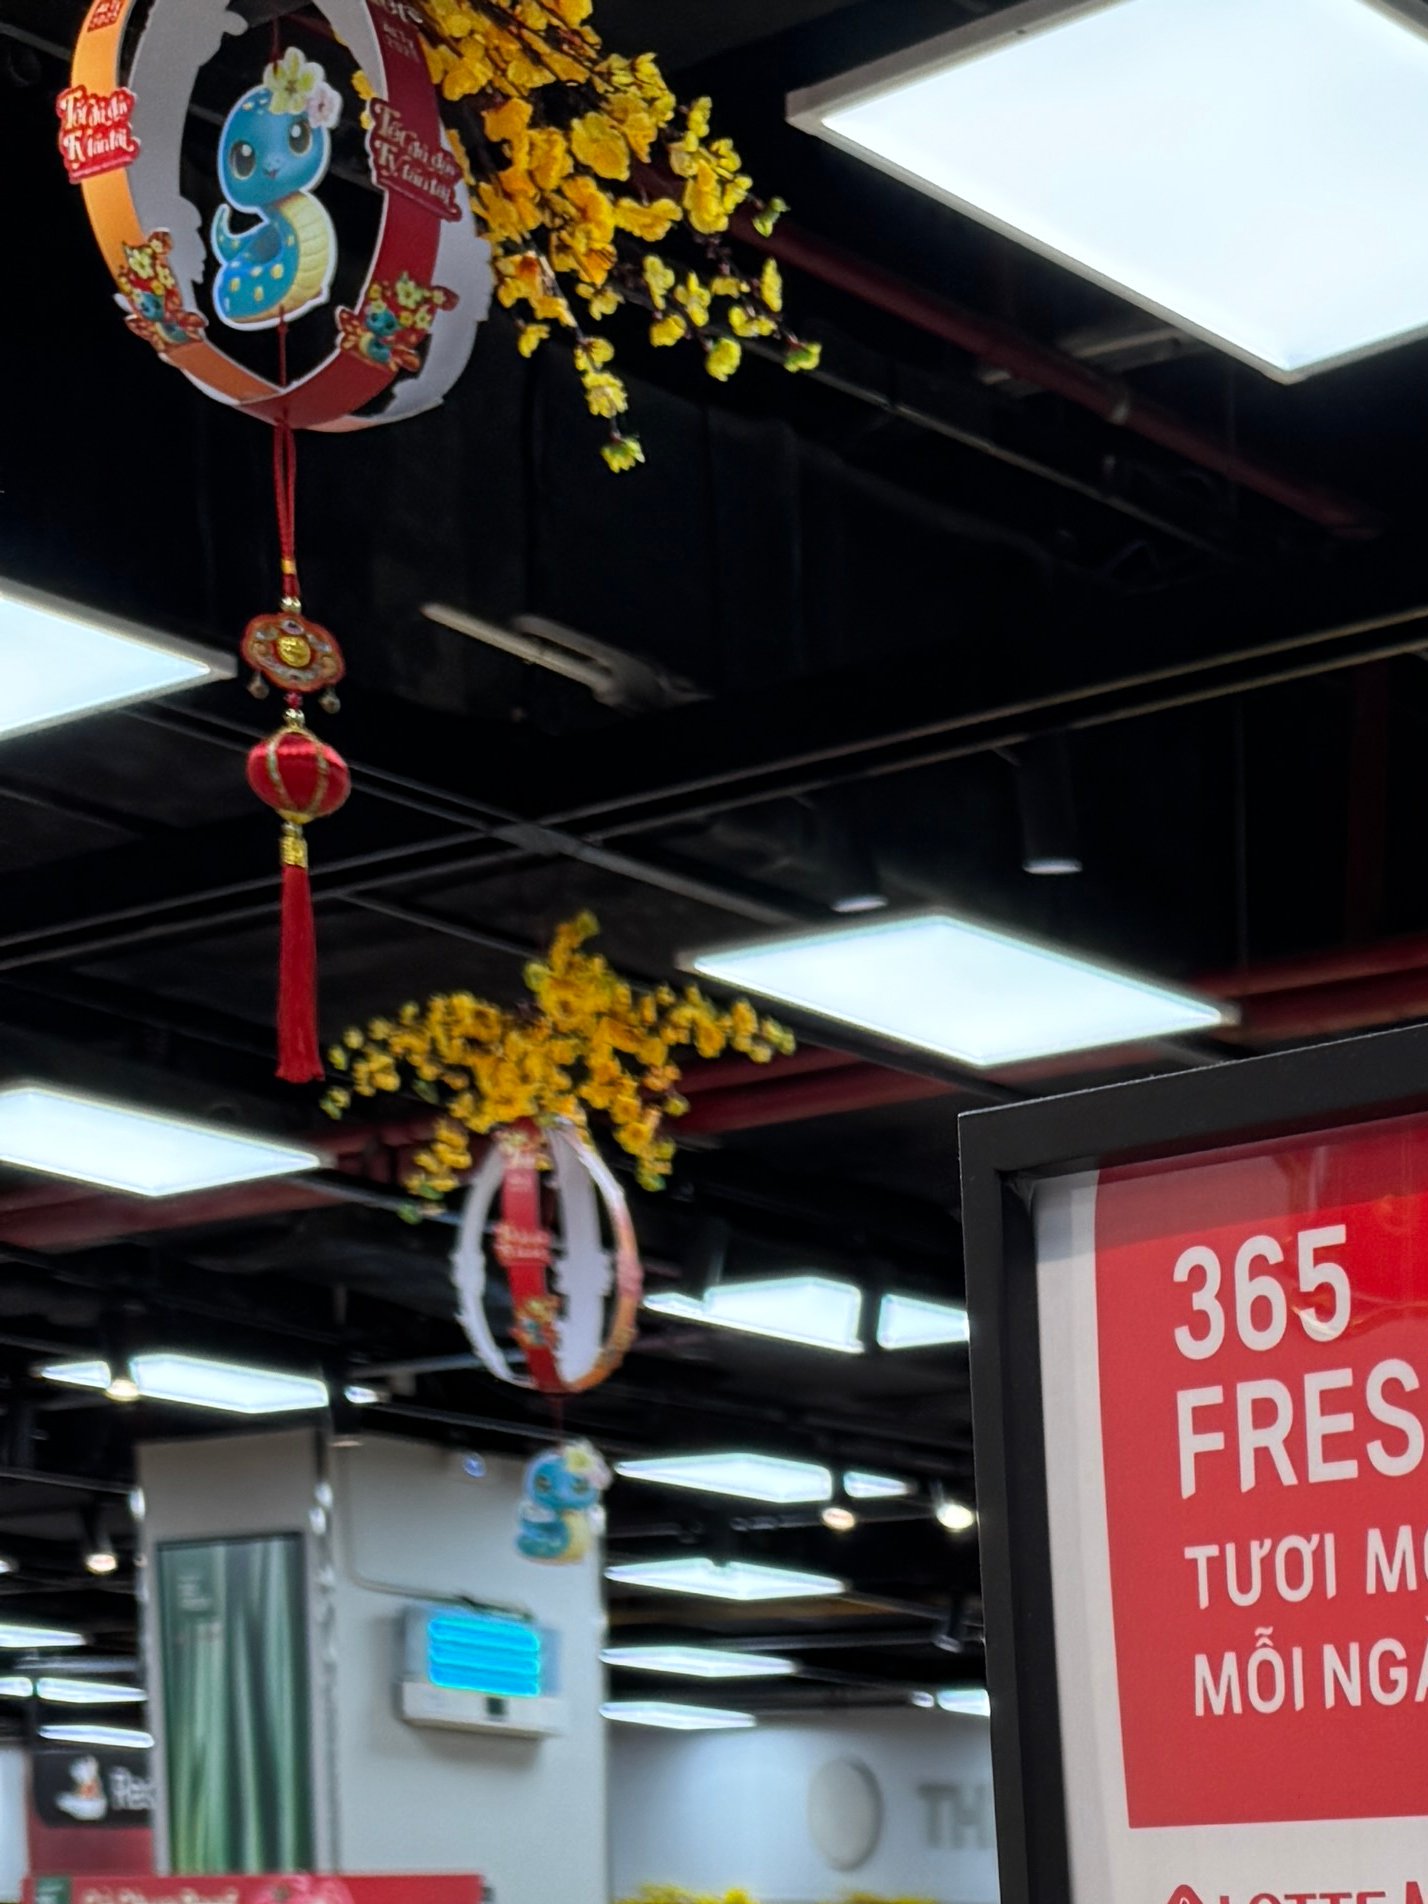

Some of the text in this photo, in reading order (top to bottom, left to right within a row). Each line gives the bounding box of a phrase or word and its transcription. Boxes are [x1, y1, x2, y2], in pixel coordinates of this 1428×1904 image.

[1172, 1224, 1351, 1361] 365
[1184, 1532, 1336, 1610] TƯƠI
[1193, 1627, 1305, 1717] MỖI
